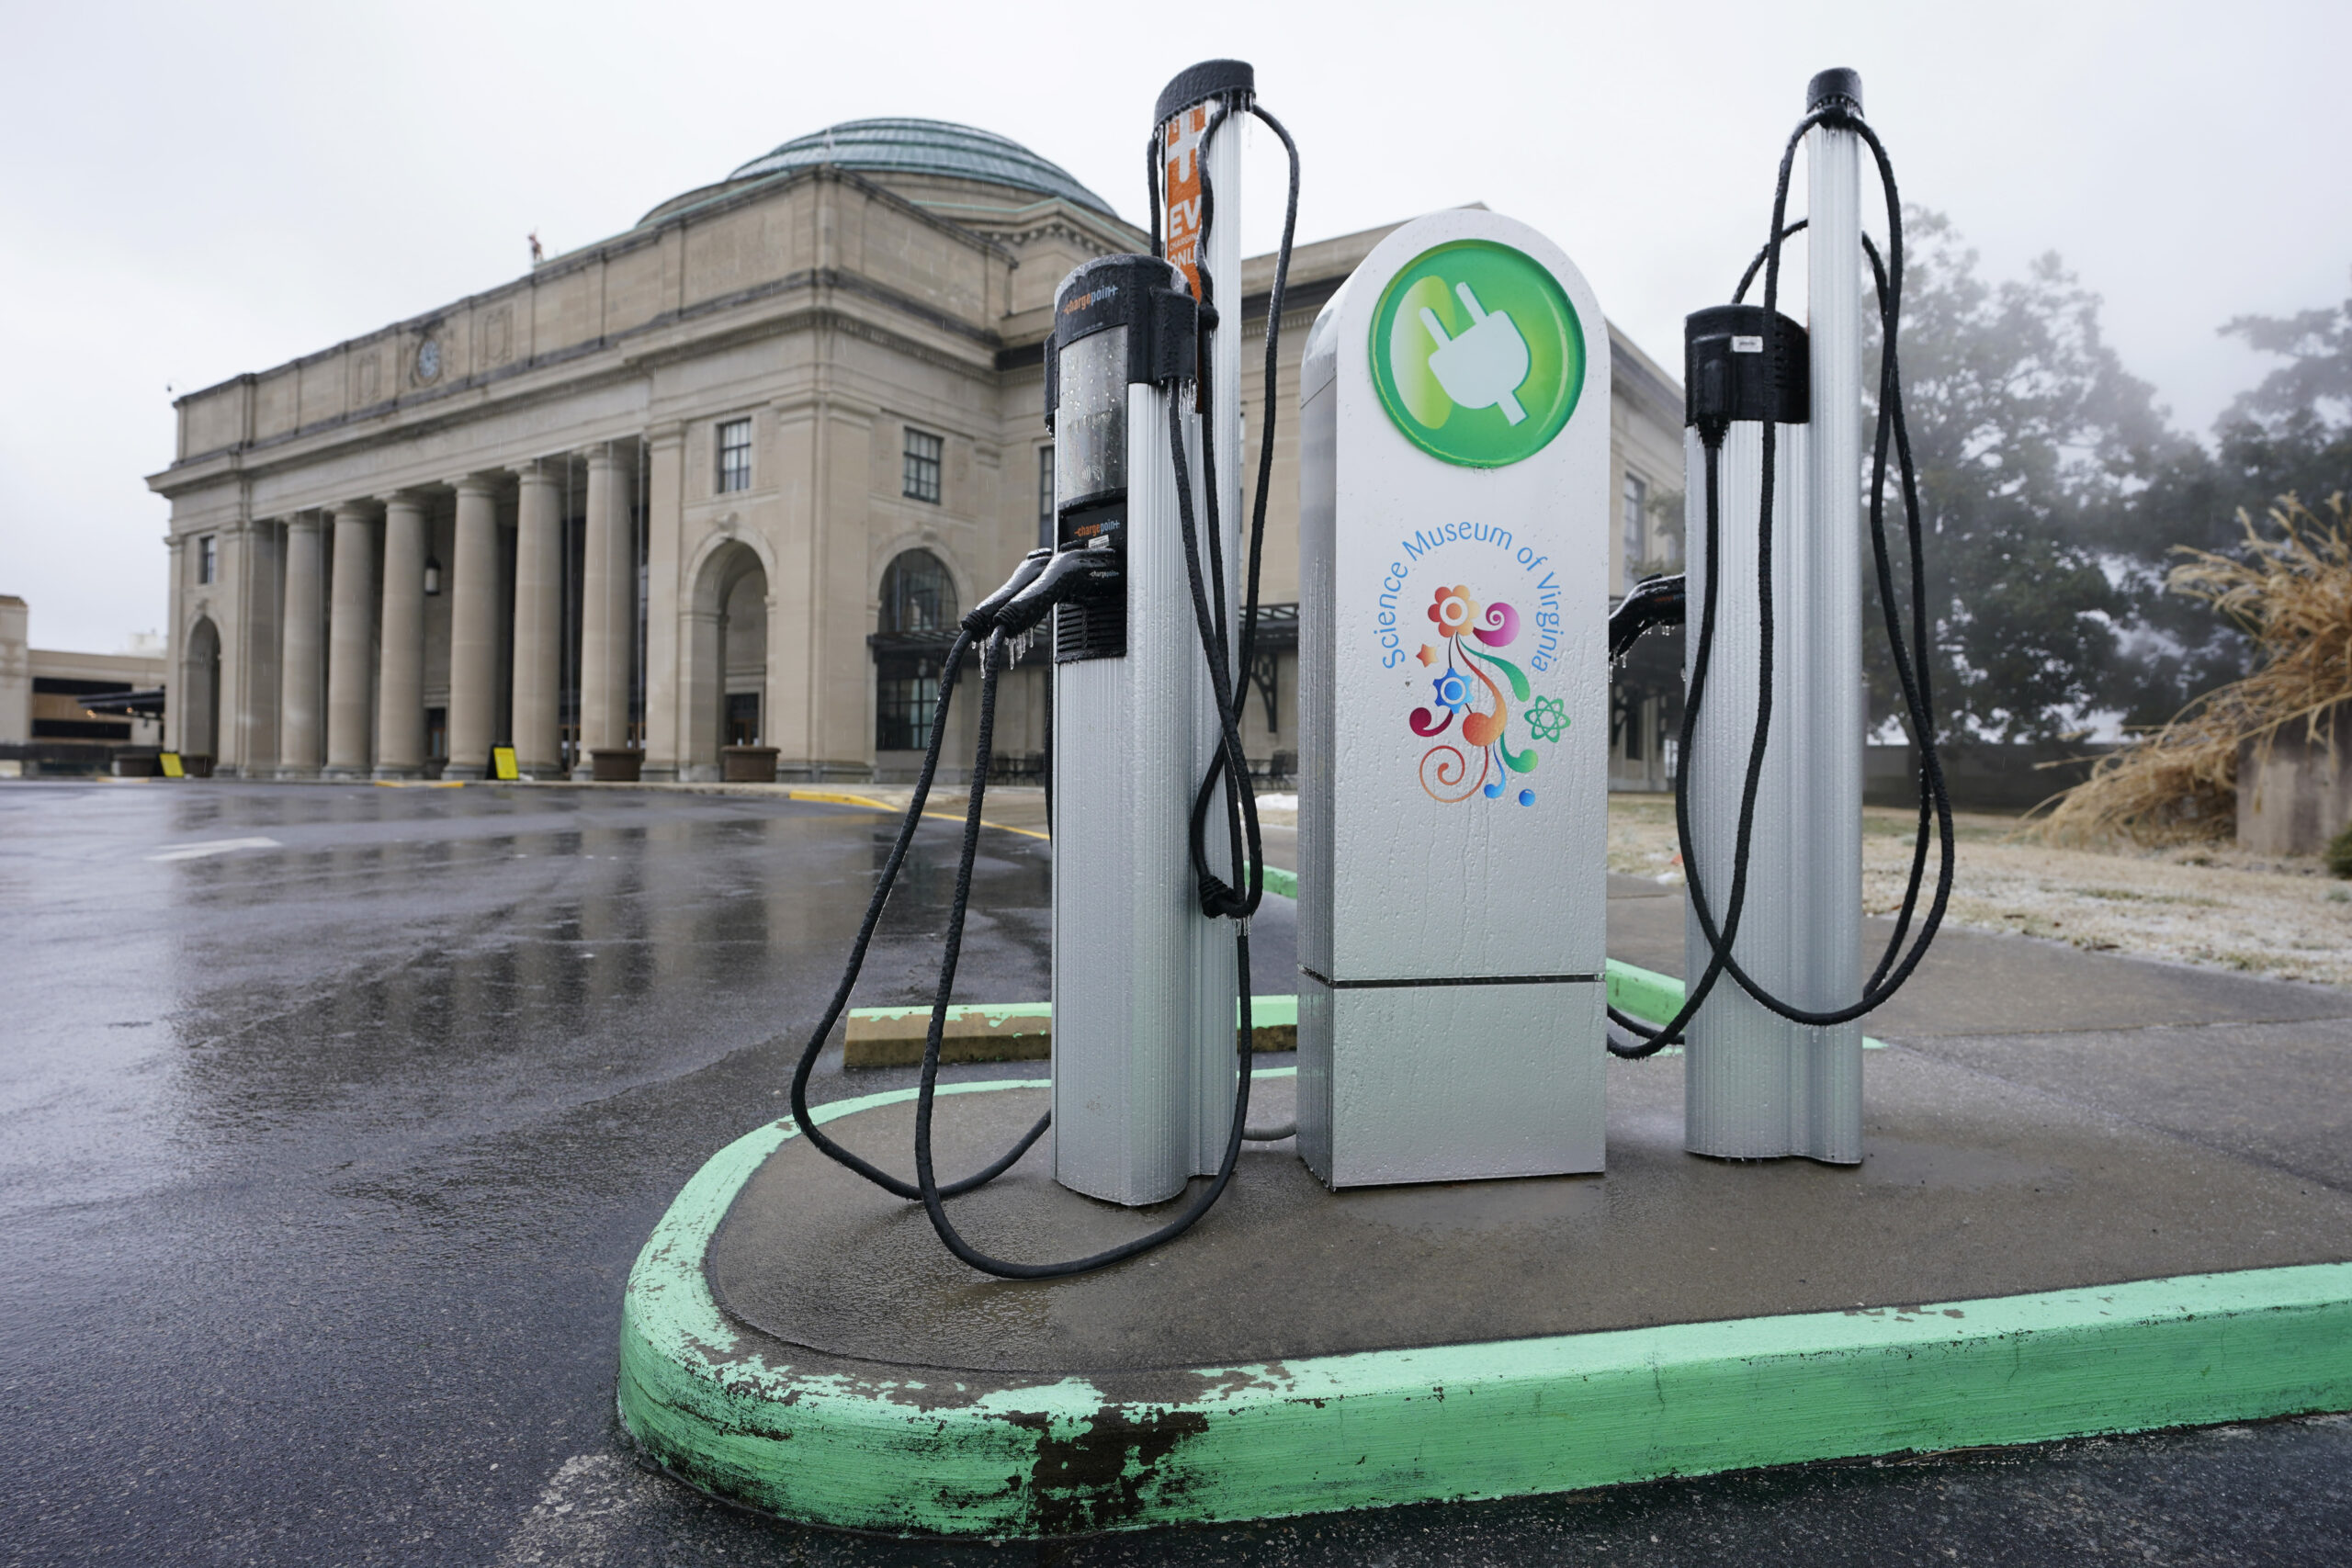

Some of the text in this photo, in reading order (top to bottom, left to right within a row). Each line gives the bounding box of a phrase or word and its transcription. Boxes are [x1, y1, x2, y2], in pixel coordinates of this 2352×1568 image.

[1170, 194, 1202, 239] EV
[1169, 232, 1198, 252] CHARGIN
[1170, 247, 1195, 269] ONL
[1374, 522, 1564, 671] Science Museum of Virginia
